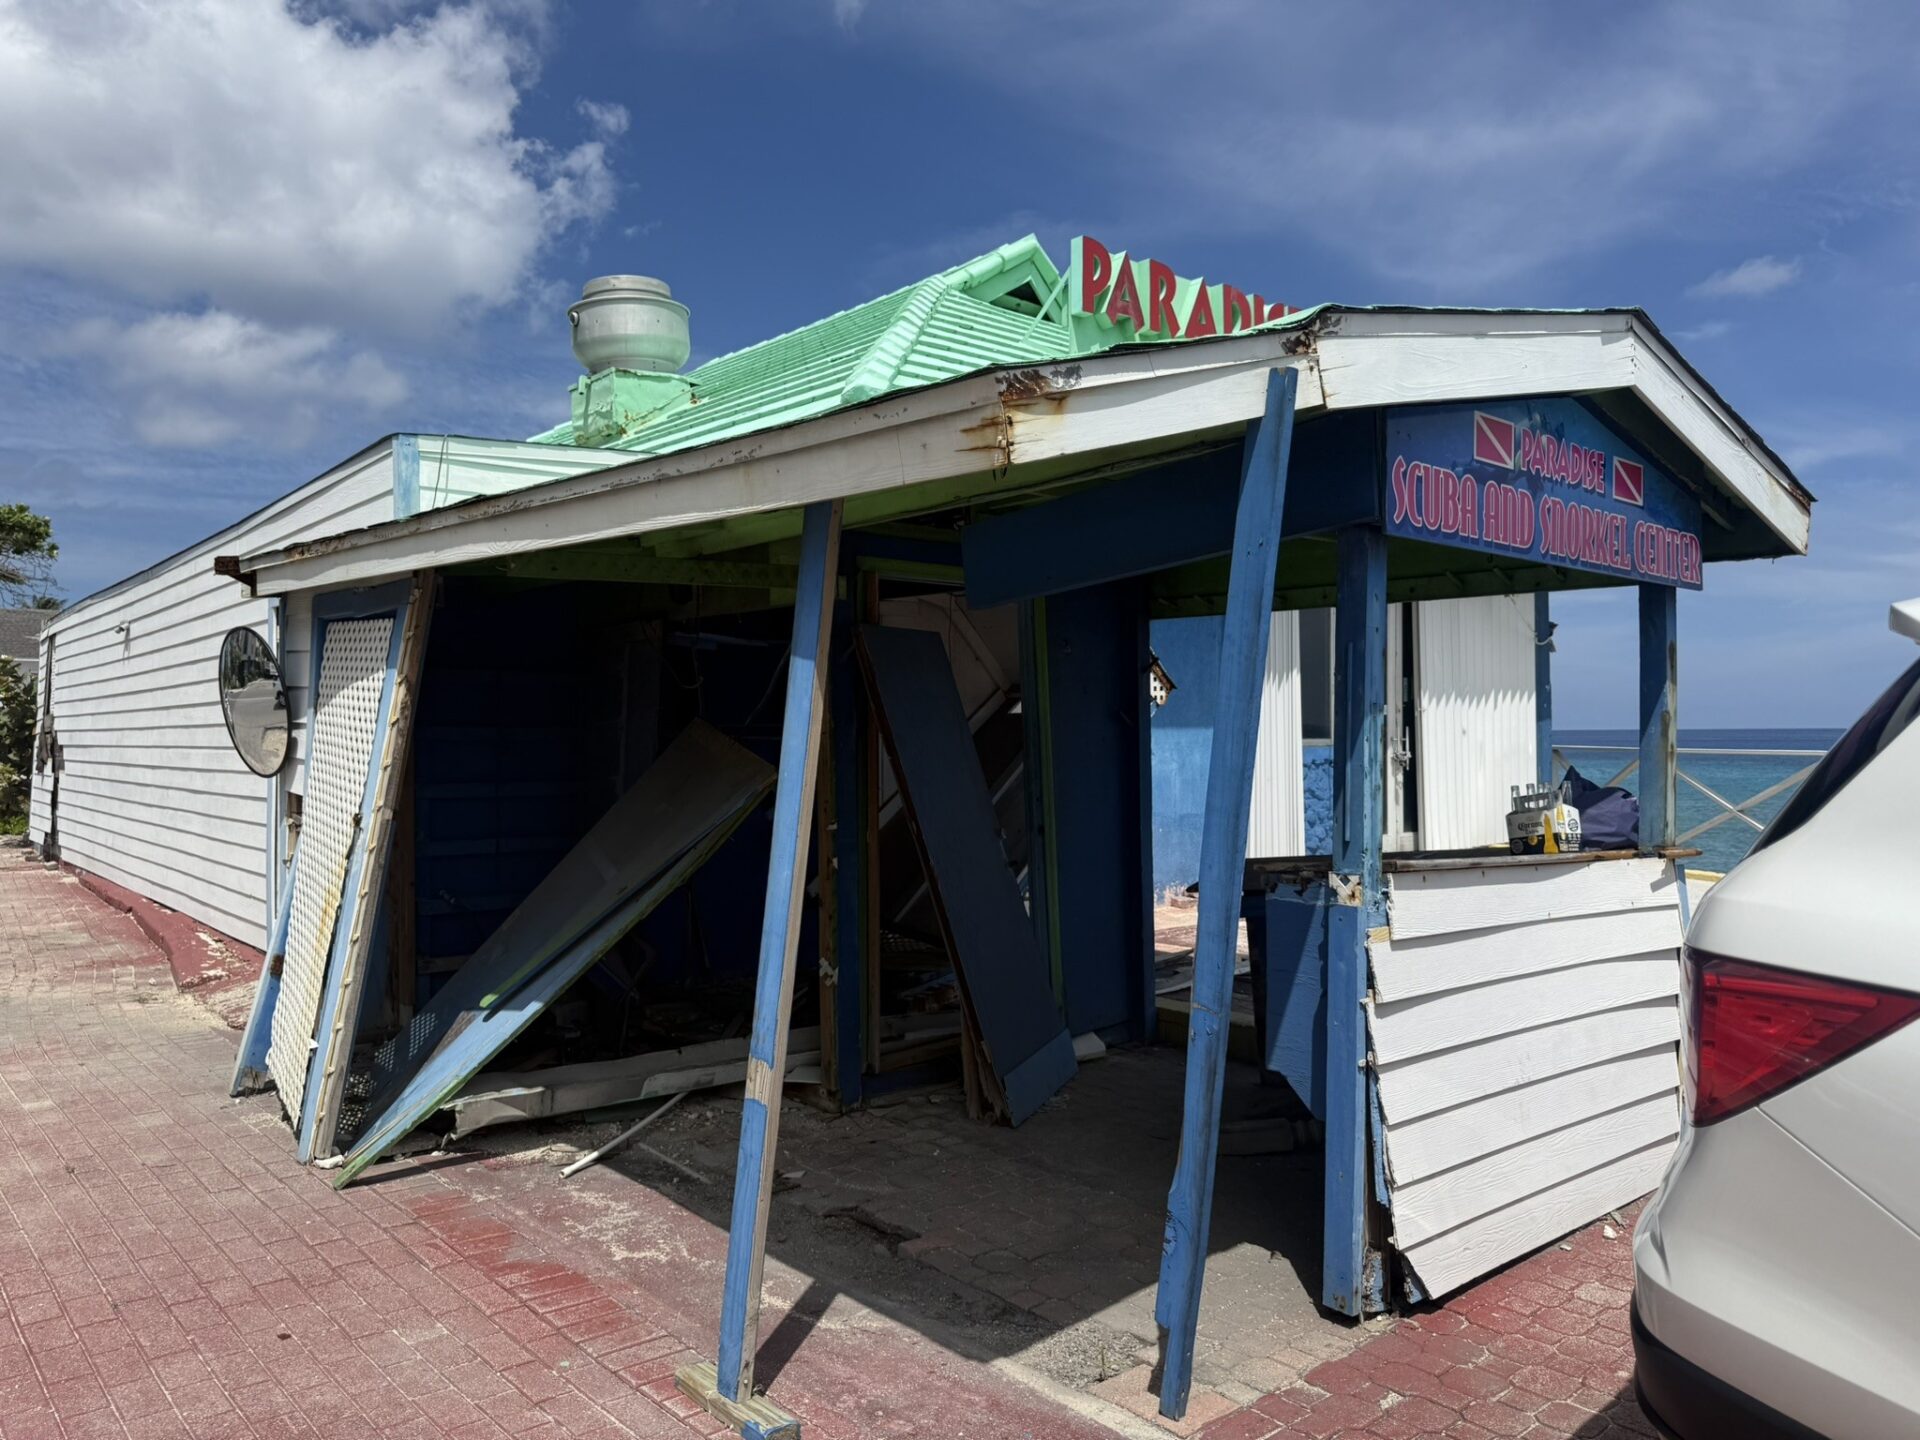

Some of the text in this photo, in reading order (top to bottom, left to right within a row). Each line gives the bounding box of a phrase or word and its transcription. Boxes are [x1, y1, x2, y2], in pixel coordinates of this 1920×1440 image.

[1520, 428, 1605, 493] PARADISE
[1392, 455, 1701, 585] SCUBA AND SNORKEL CENTER
